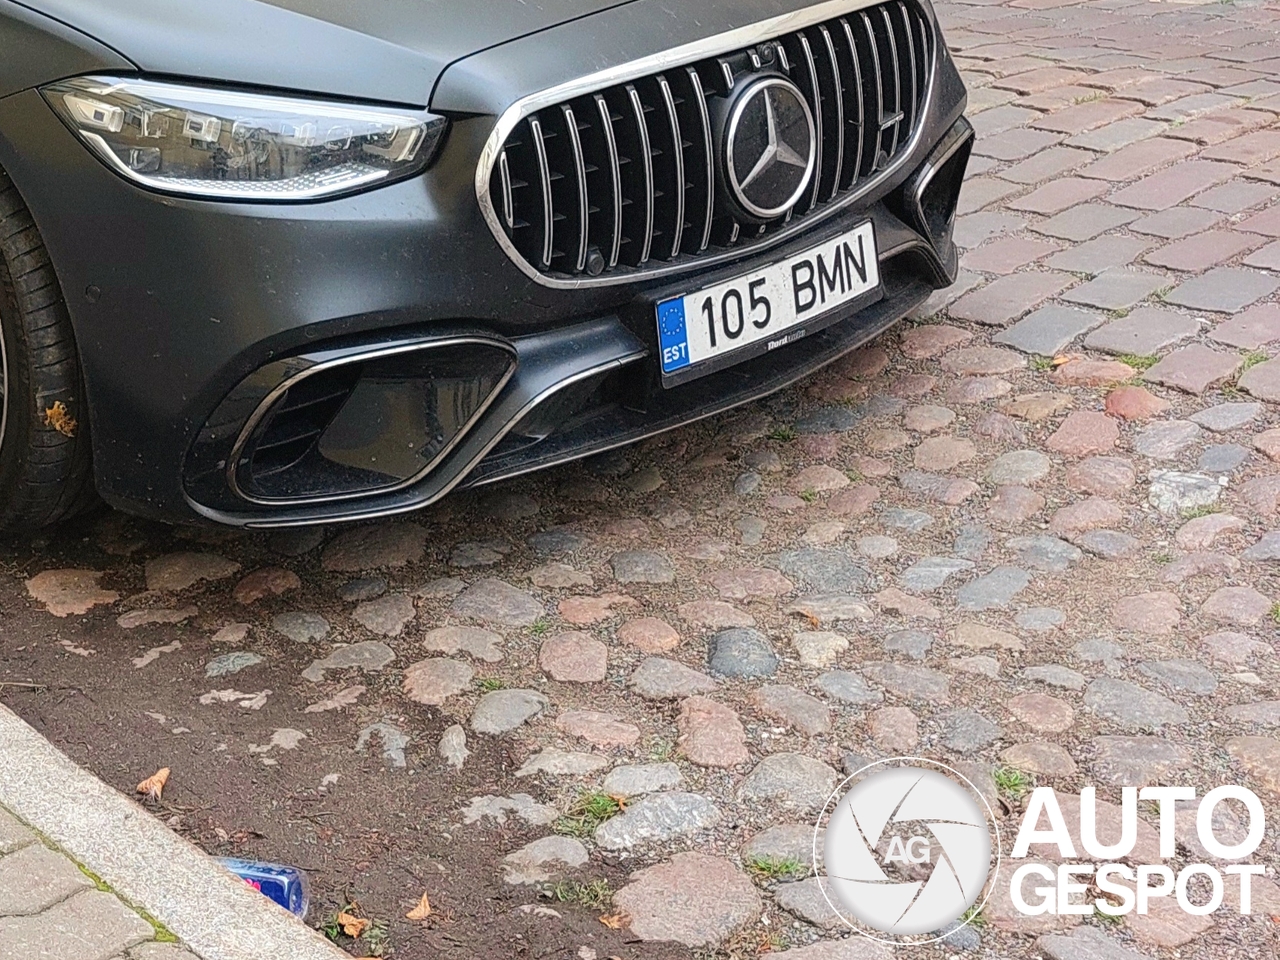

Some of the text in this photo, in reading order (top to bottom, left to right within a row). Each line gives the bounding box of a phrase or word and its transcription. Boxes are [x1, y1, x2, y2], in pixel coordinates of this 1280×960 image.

[701, 234, 868, 348] 105 BMN
[663, 342, 687, 364] EST
